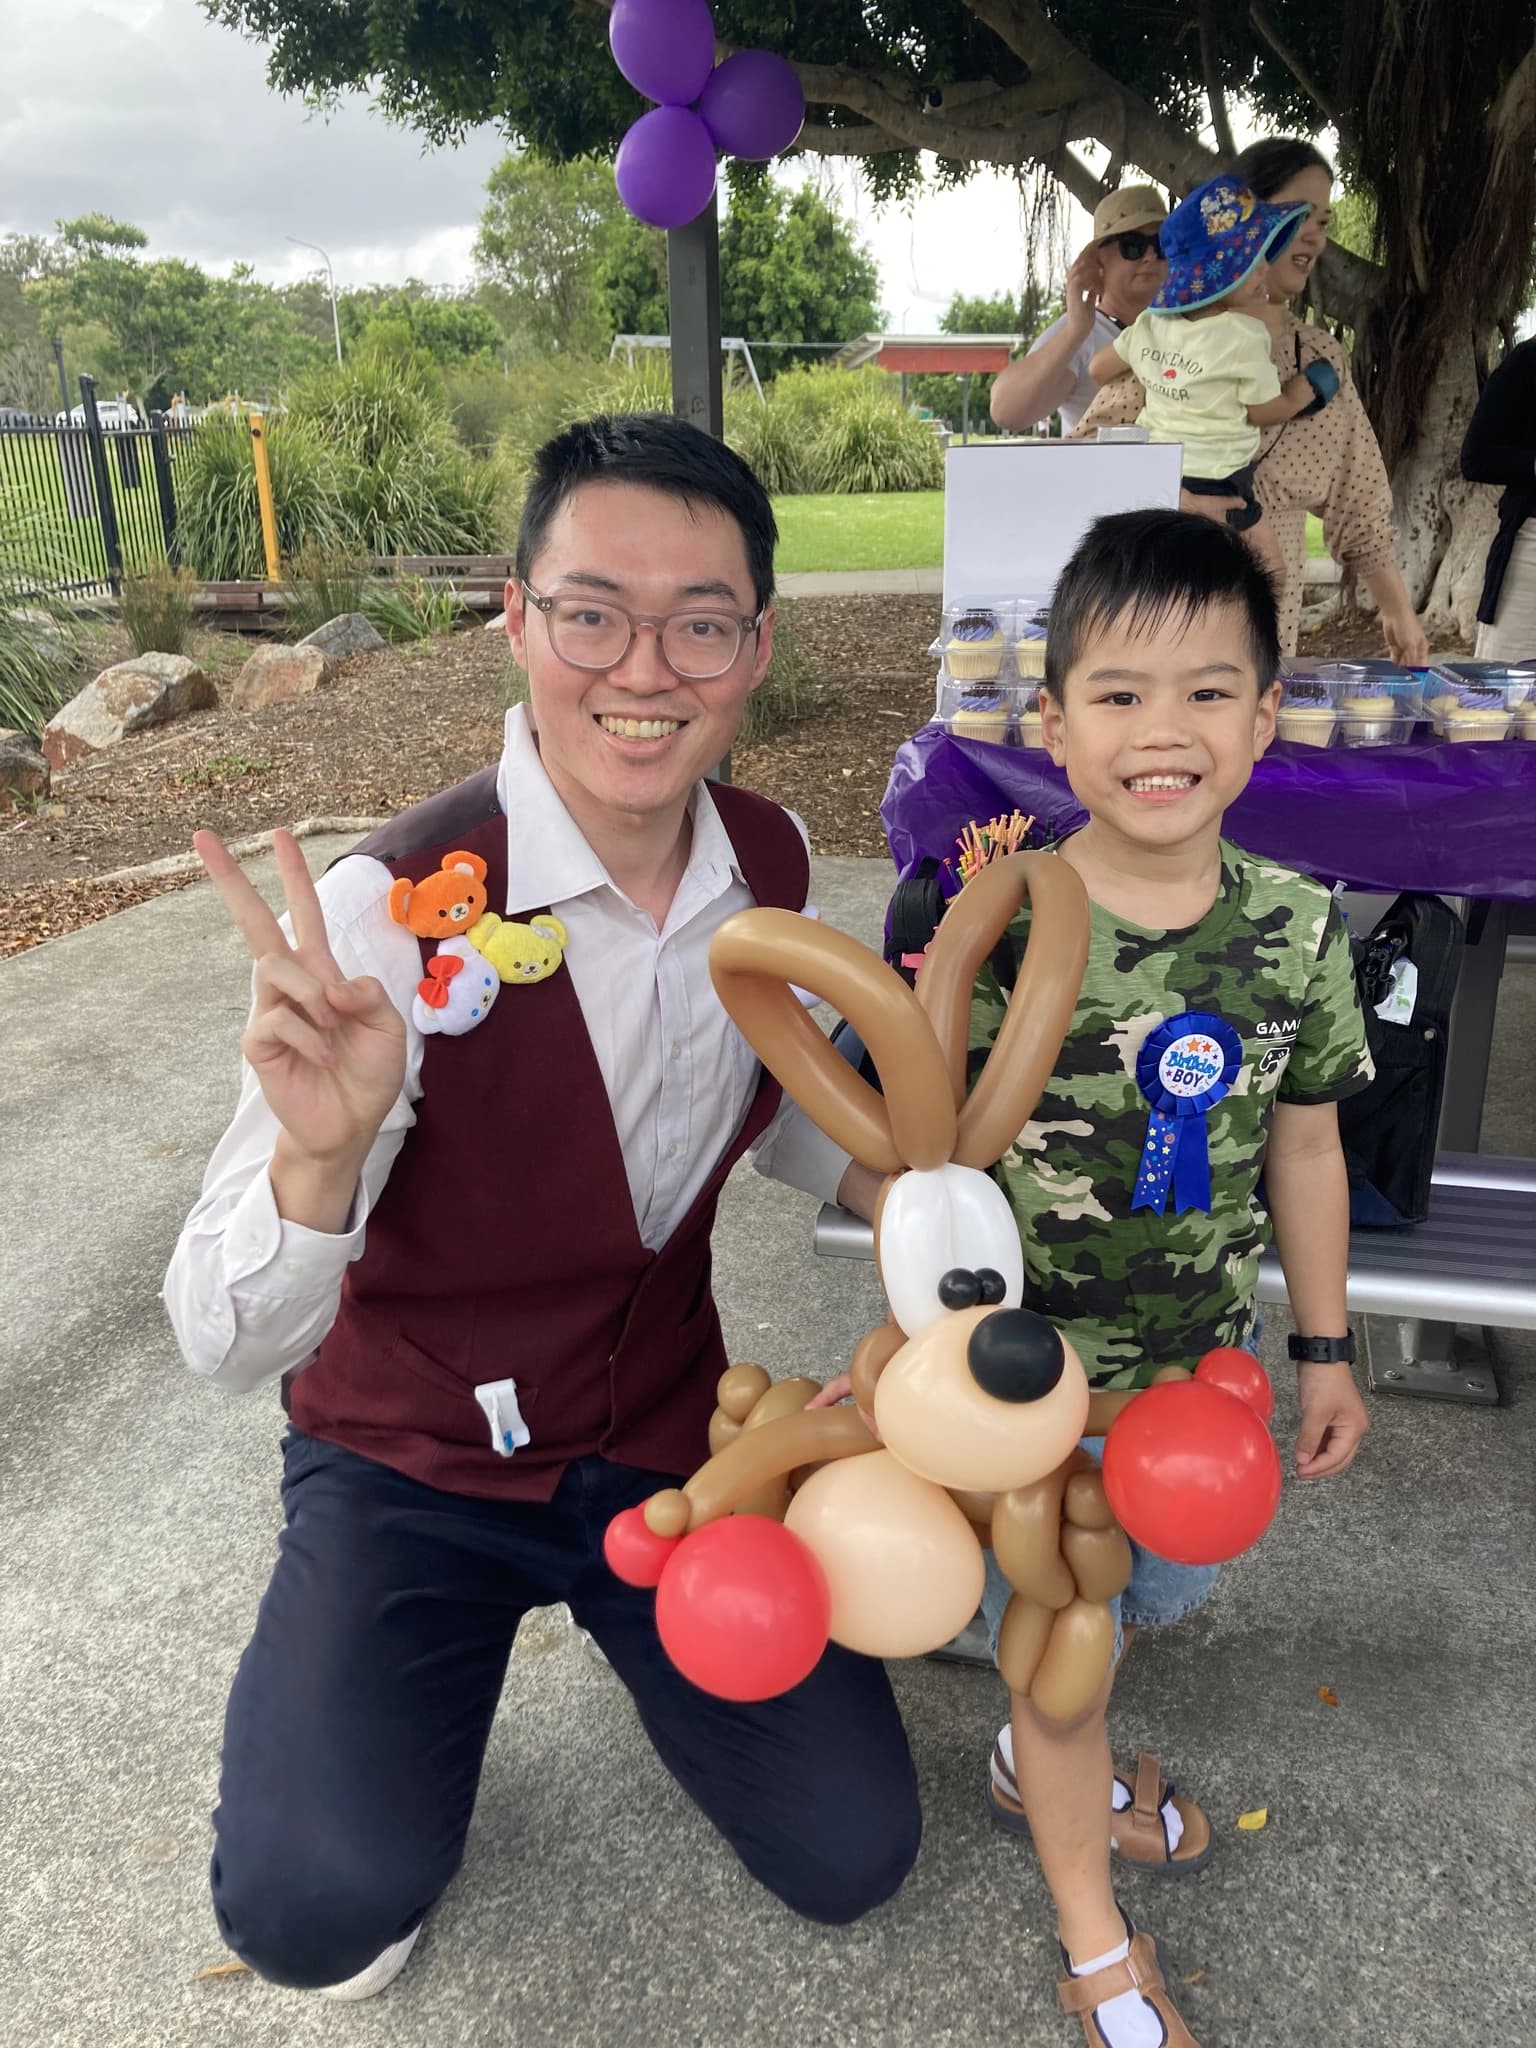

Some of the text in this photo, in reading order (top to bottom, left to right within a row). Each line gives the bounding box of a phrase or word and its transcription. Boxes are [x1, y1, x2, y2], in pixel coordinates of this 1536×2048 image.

[1256, 1018, 1301, 1035] GAM
[1166, 1051, 1220, 1079] Birthday
[1172, 1069, 1205, 1088] BOY
